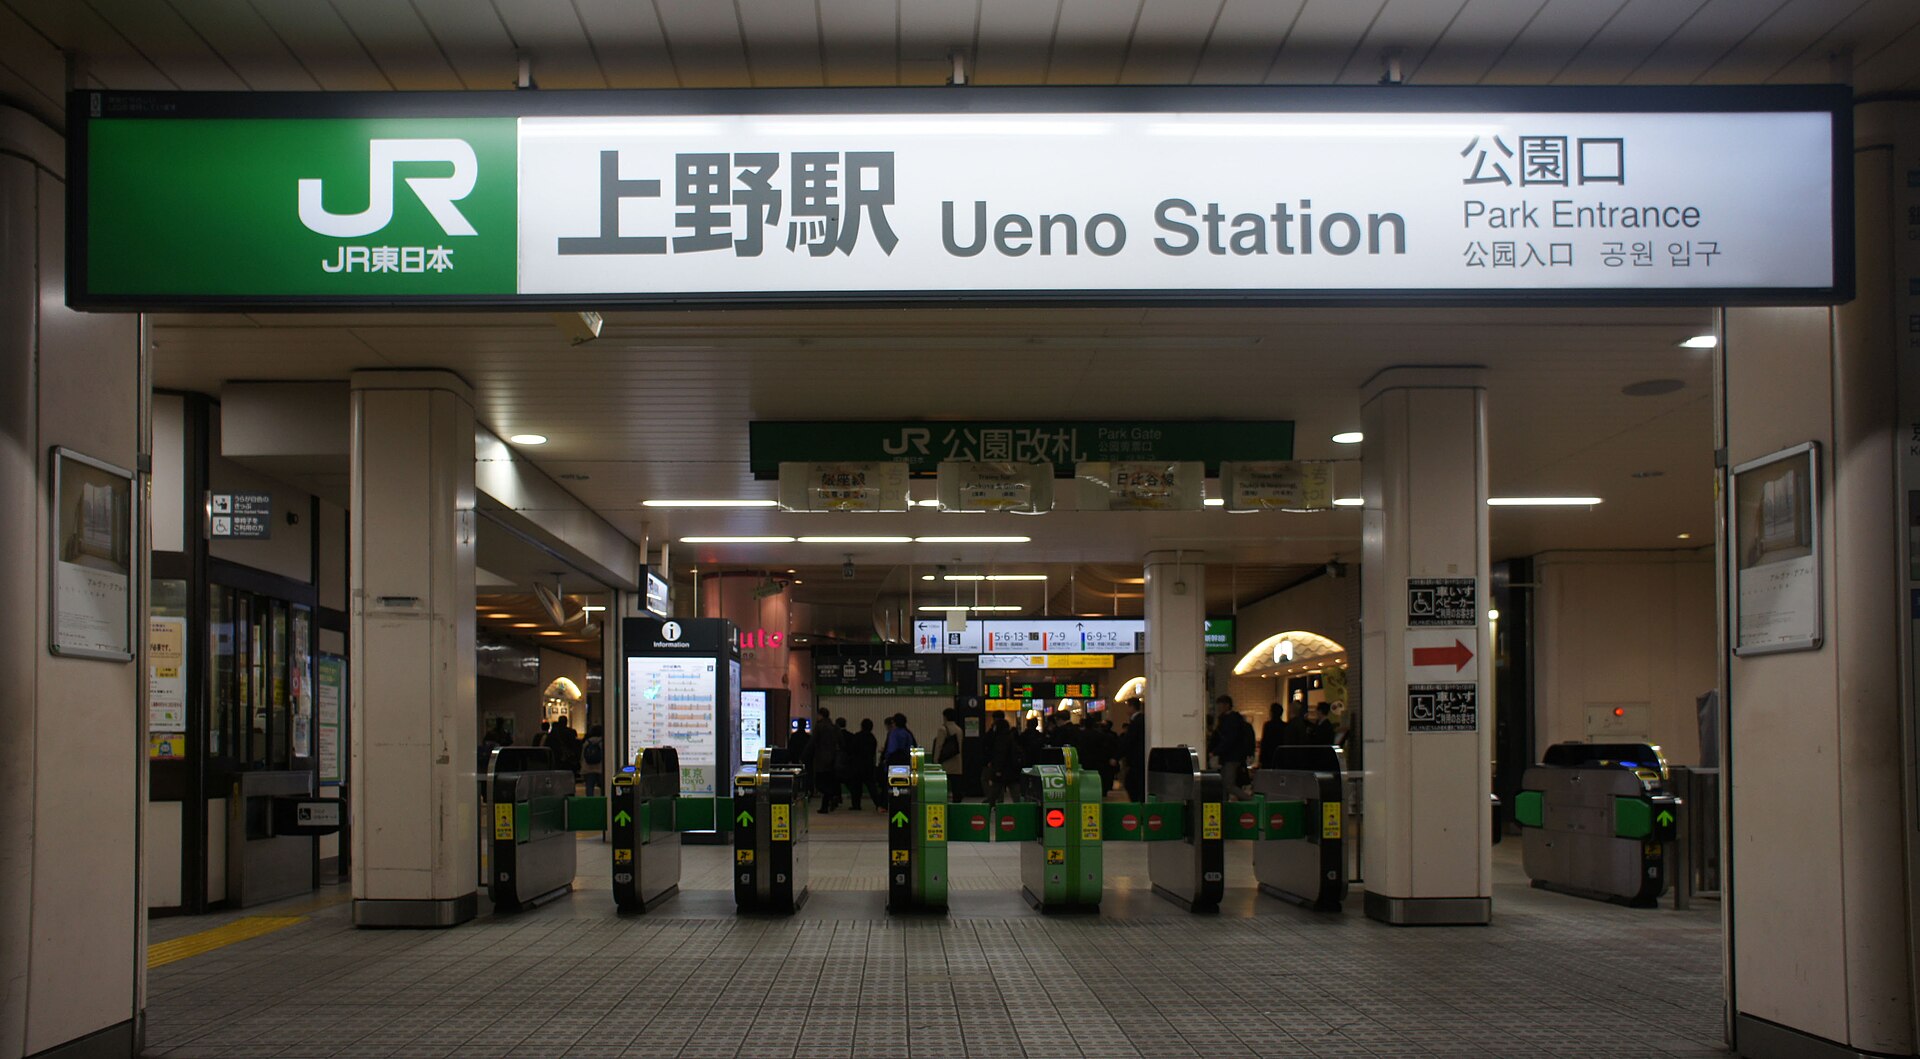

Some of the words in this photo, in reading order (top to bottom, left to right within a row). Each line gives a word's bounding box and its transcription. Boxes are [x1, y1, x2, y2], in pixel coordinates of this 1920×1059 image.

[1460, 134, 1625, 188] 公園口
[298, 138, 479, 238] JR
[558, 151, 899, 258] 上野駅
[1464, 200, 1539, 229] Park
[1552, 200, 1701, 229] Entrance
[942, 200, 1126, 258] Ueno
[1153, 198, 1406, 257] Station
[322, 244, 454, 273] JR東日本
[1463, 241, 1573, 269] 公园入口
[1600, 240, 1654, 268] 공원
[1667, 240, 1722, 268] 입구
[883, 428, 930, 455] JR
[942, 428, 1088, 464] 公園改札
[1098, 427, 1127, 440] Park
[1130, 427, 1162, 440] Gate
[1435, 586, 1474, 597] 車いす
[1435, 597, 1474, 608] ベビーカー
[842, 685, 896, 695] Information
[1435, 691, 1474, 702] 車いす
[1435, 702, 1474, 713] ベビーカー
[1044, 776, 1064, 788] IC
